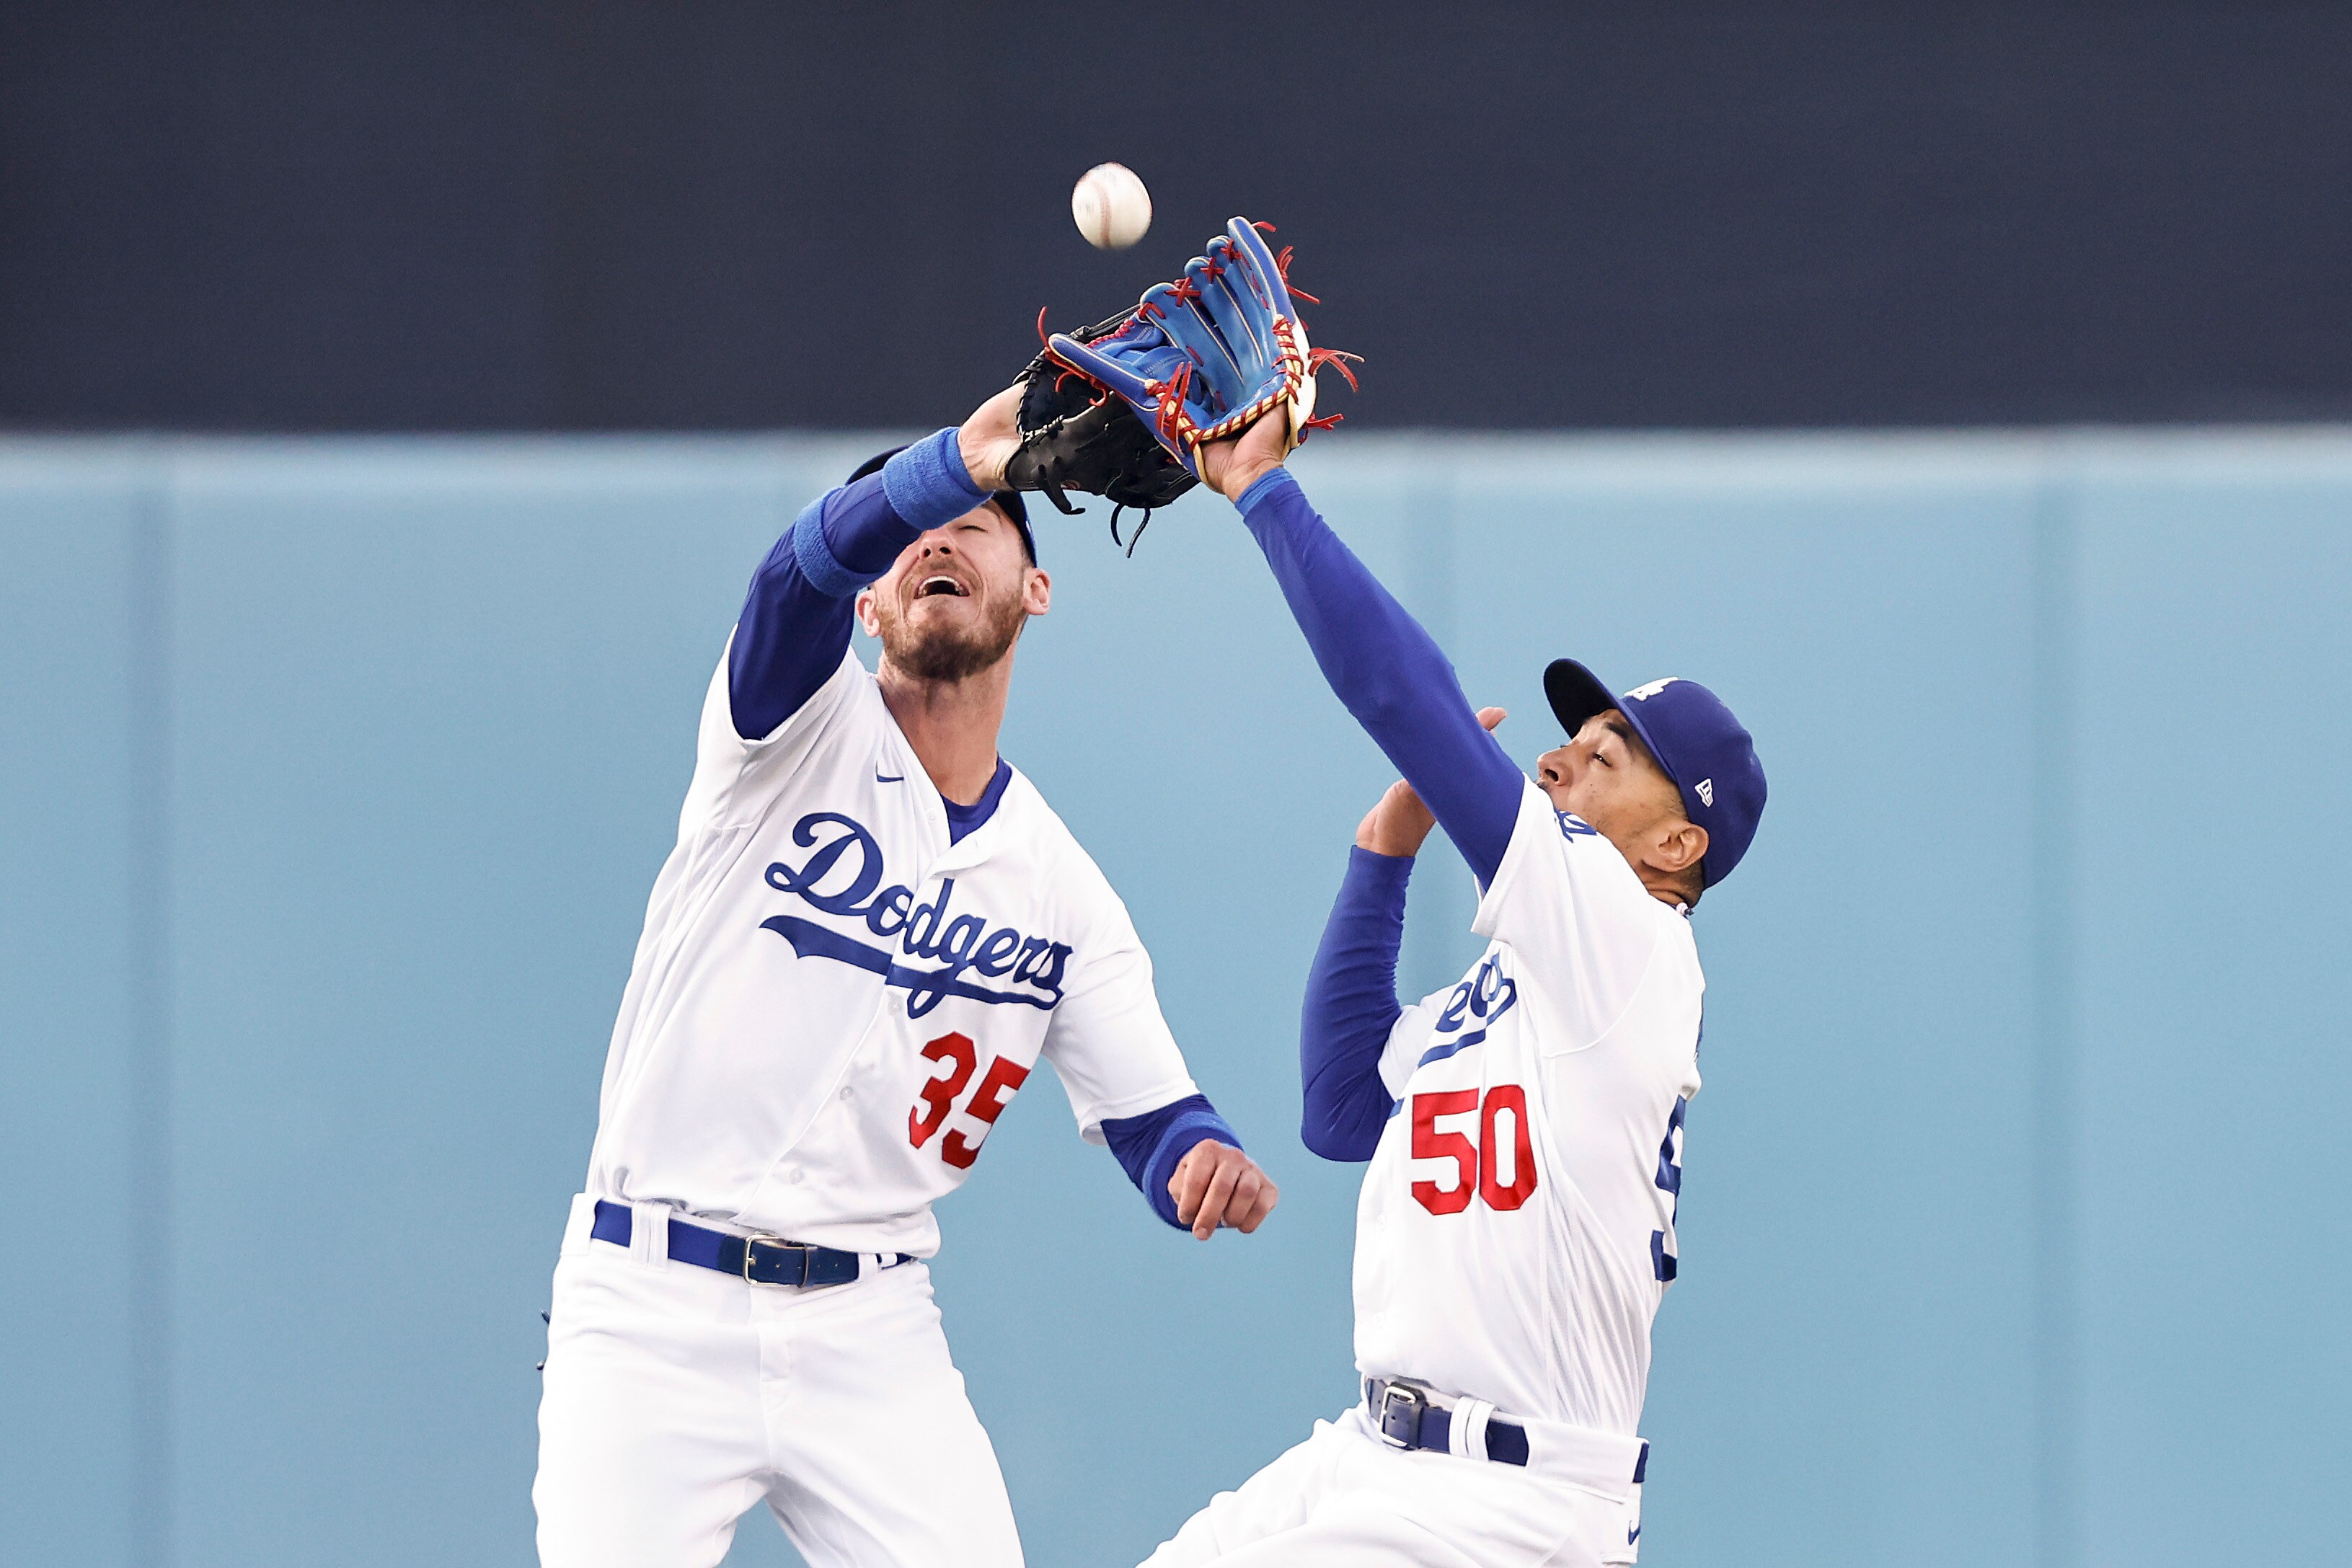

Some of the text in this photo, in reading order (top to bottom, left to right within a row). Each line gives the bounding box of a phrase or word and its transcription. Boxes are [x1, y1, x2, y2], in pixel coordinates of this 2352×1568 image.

[762, 812, 1074, 1019] Dodgers
[908, 1031, 1031, 1169] 35
[1411, 1084, 1538, 1215] 50
